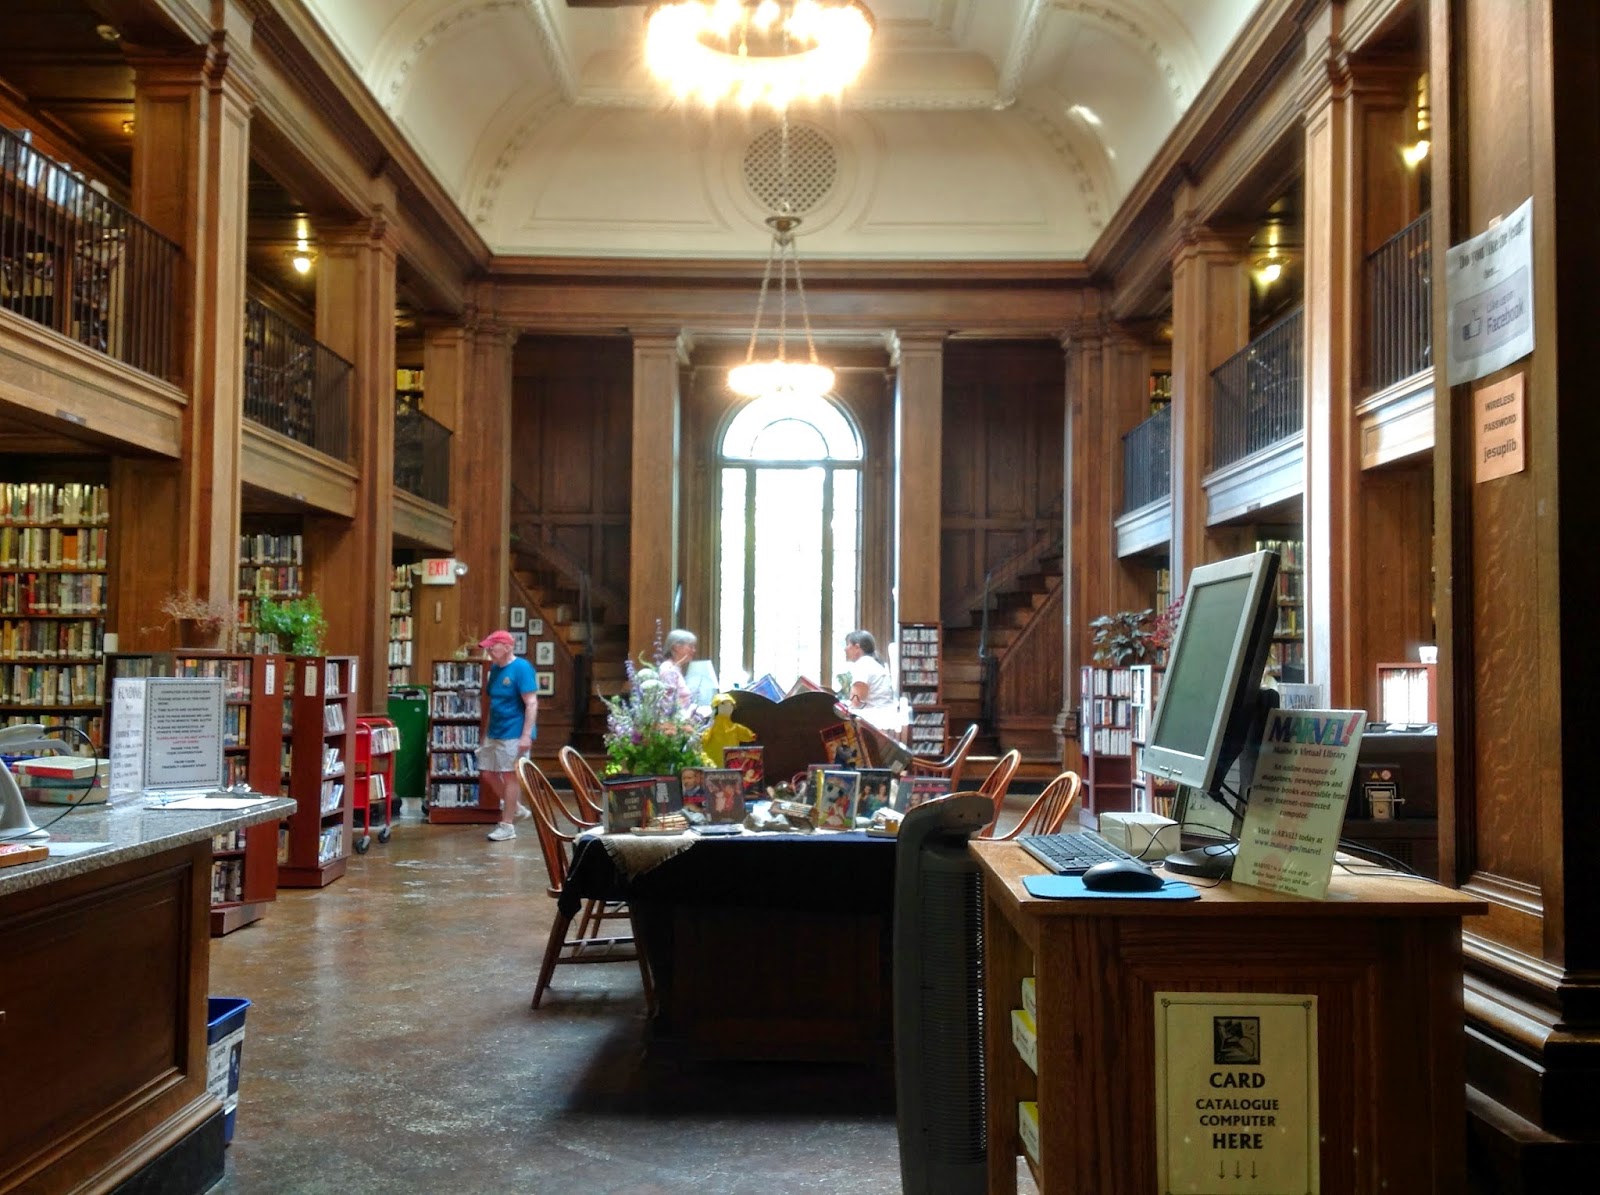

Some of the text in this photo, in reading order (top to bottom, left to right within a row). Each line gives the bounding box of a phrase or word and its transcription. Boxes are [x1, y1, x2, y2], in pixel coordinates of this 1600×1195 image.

[1487, 297, 1524, 336] Facebook
[1485, 393, 1515, 412] WIRELESS
[1483, 413, 1517, 433] PASSWORD
[1483, 438, 1517, 463] jesuplib
[428, 560, 449, 576] EXIT
[1269, 713, 1362, 747] MARVEL!
[1300, 747, 1322, 757] Virtual
[1323, 749, 1347, 760] Library
[1302, 766, 1328, 775] resource
[1329, 768, 1337, 776] of
[1294, 778, 1330, 788] newspapers
[1281, 786, 1299, 795] books
[1300, 788, 1331, 799] accessible
[1332, 792, 1346, 801] from
[1299, 834, 1315, 844] today
[1209, 1072, 1266, 1089] CARD
[1195, 1098, 1280, 1111] CATALOGUE
[1199, 1115, 1276, 1127] COMPUTER
[1212, 1133, 1264, 1150] HERE
